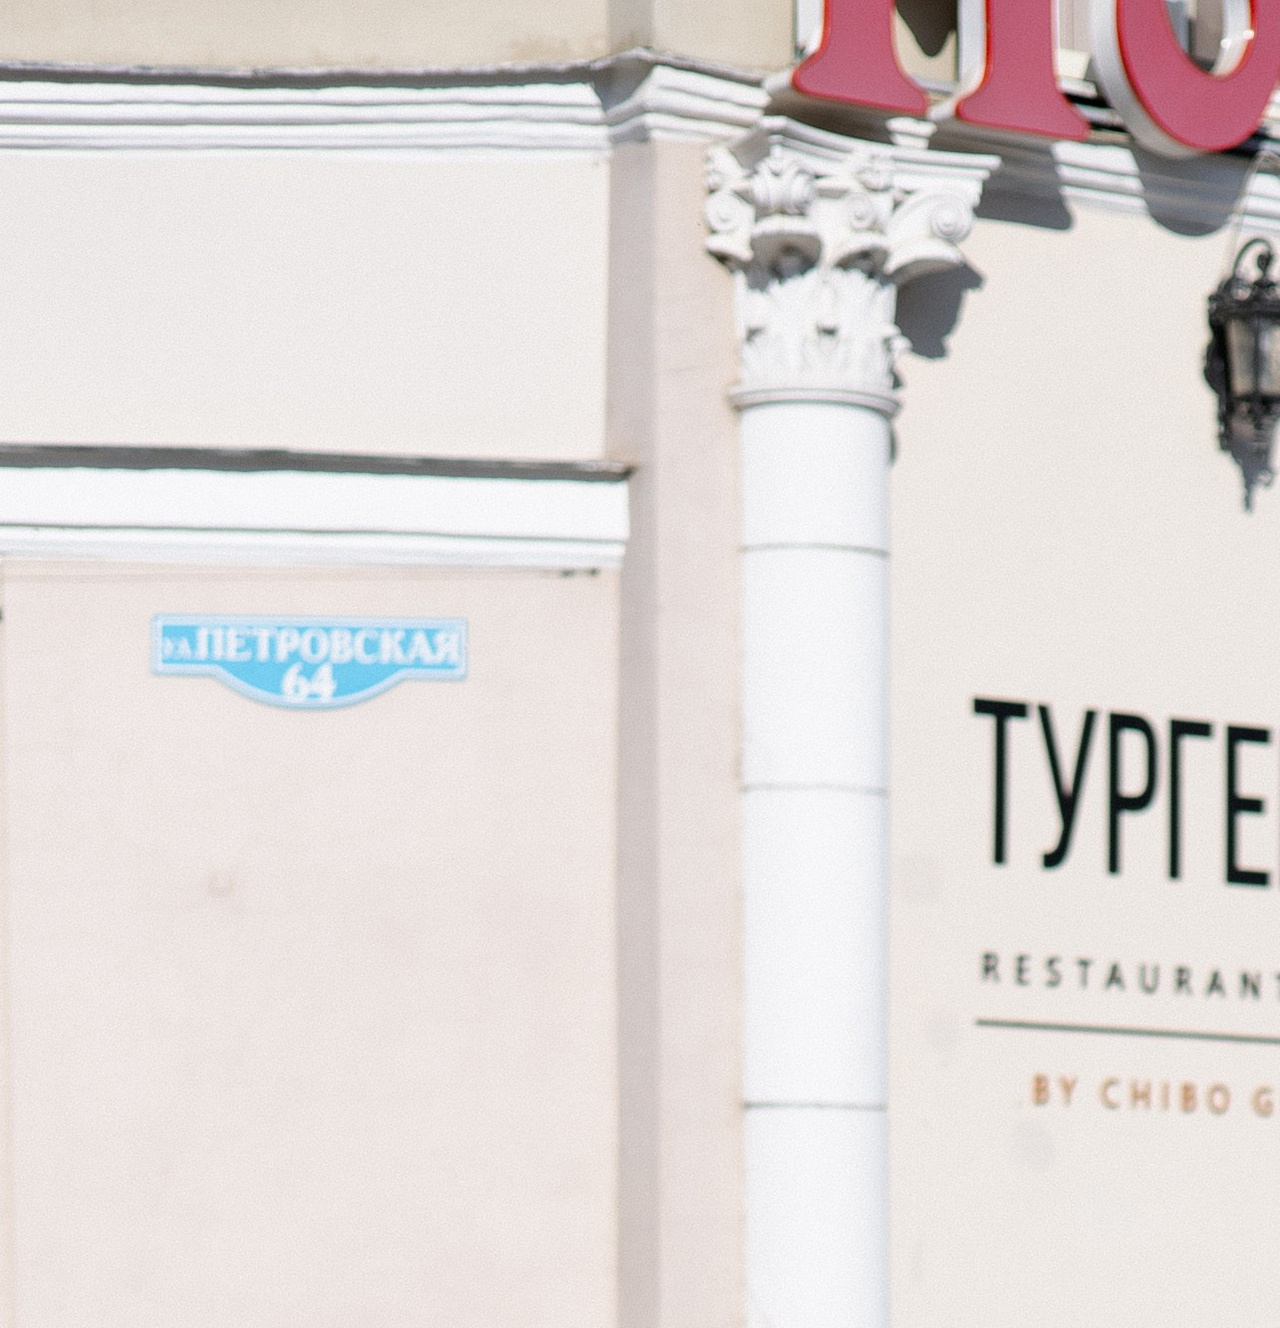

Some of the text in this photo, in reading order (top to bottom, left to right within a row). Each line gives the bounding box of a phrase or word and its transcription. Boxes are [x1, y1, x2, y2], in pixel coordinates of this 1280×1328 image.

[197, 626, 462, 666] ПЕТРОВСКАЯ
[281, 660, 337, 703] 64
[1030, 1071, 1078, 1105] BY
[1098, 1075, 1232, 1114] CHIBO
